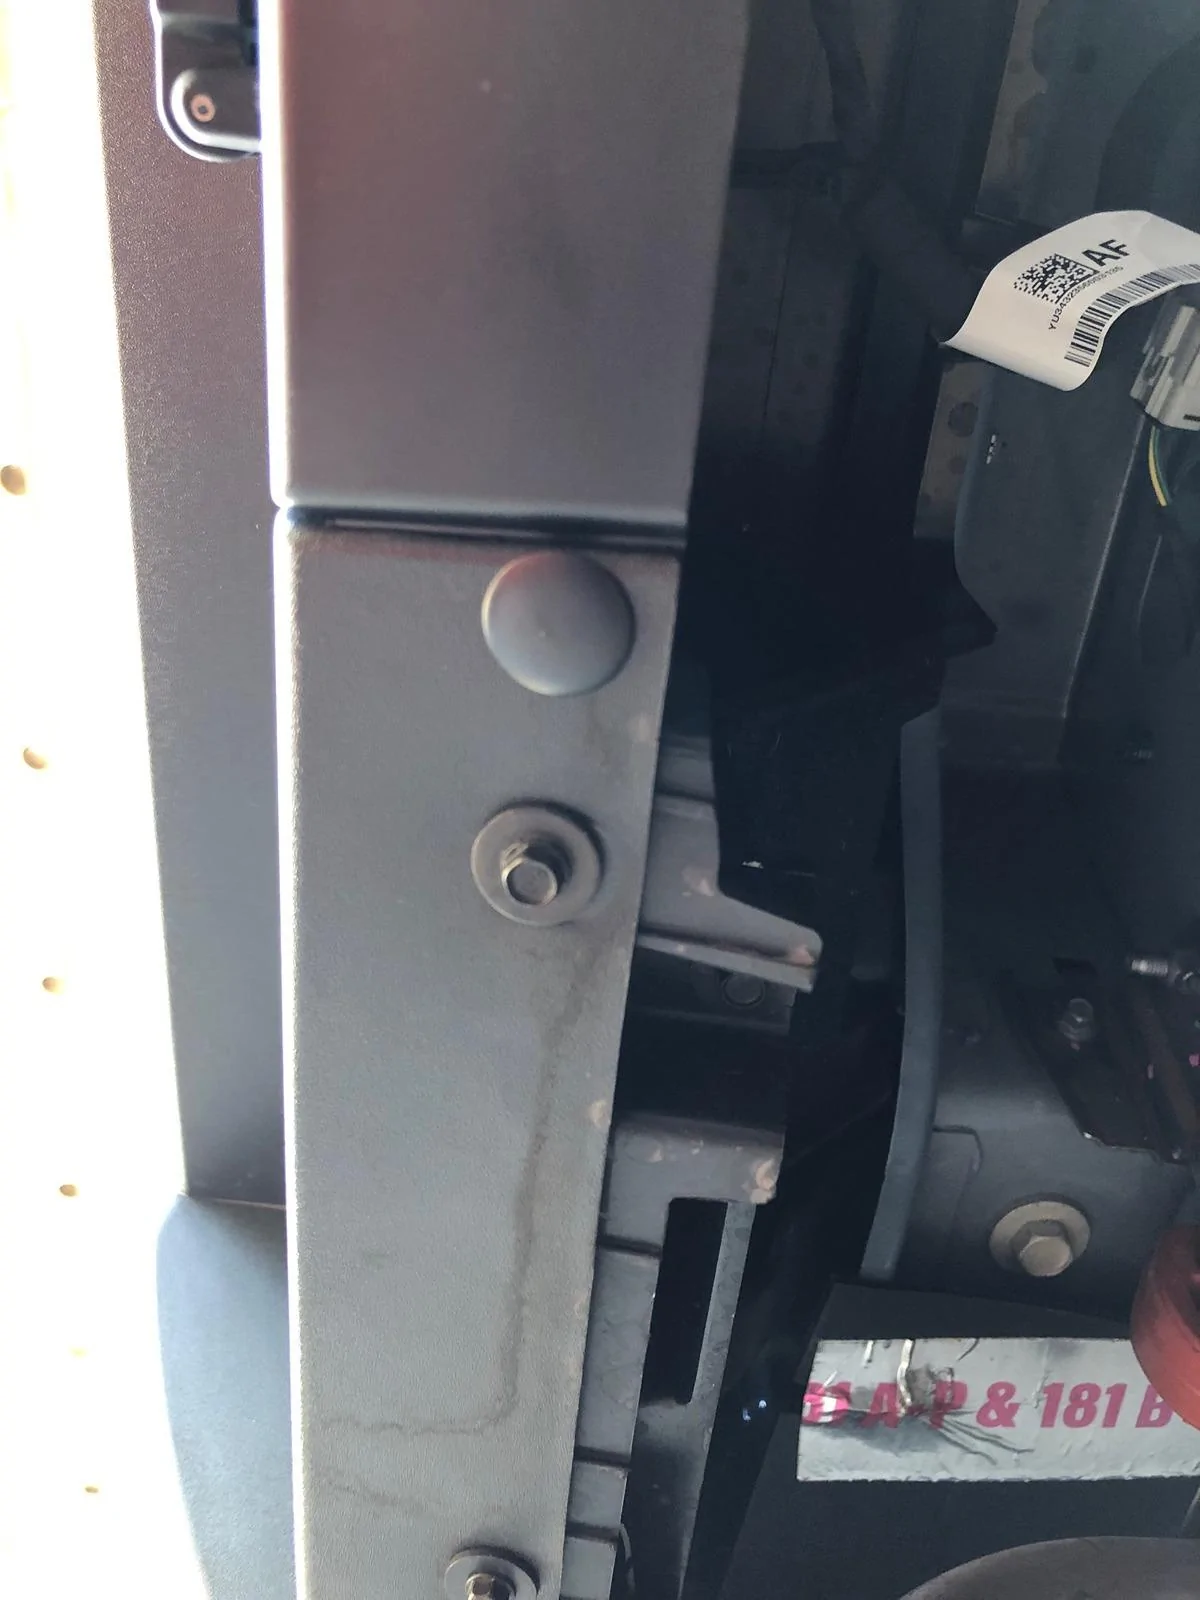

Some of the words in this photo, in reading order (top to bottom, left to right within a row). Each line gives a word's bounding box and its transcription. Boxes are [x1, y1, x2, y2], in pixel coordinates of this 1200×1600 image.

[1081, 239, 1131, 267] AF
[976, 1381, 1021, 1428] &
[1040, 1381, 1127, 1428] 181
